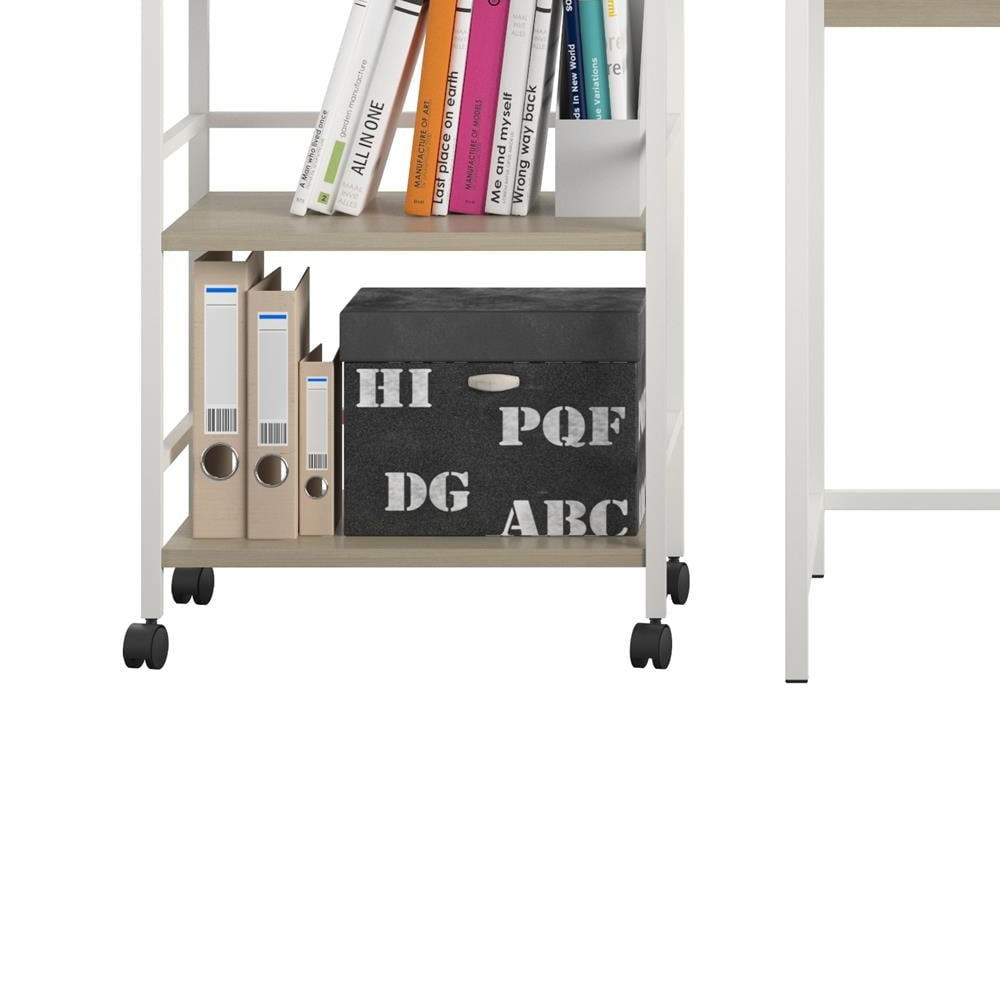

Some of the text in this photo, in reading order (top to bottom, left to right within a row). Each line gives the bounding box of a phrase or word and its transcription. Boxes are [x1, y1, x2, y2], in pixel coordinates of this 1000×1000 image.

[567, 43, 577, 70] World
[571, 72, 579, 93] New
[591, 56, 601, 106] Variations
[421, 117, 428, 128] OF
[423, 100, 431, 116] ART
[500, 91, 513, 141] myself
[307, 148, 316, 164] who
[318, 109, 328, 129] once
[351, 99, 385, 176] ALL IN ONE
[433, 71, 459, 204] Last place on earth
[512, 84, 537, 204] Wrong way back
[414, 130, 427, 188] MANUFACTURE
[496, 145, 506, 175] and
[490, 179, 502, 204] Me
[355, 367, 433, 408] HI
[499, 405, 626, 449] PQF
[384, 470, 469, 513] DG
[501, 498, 629, 537] ABC
